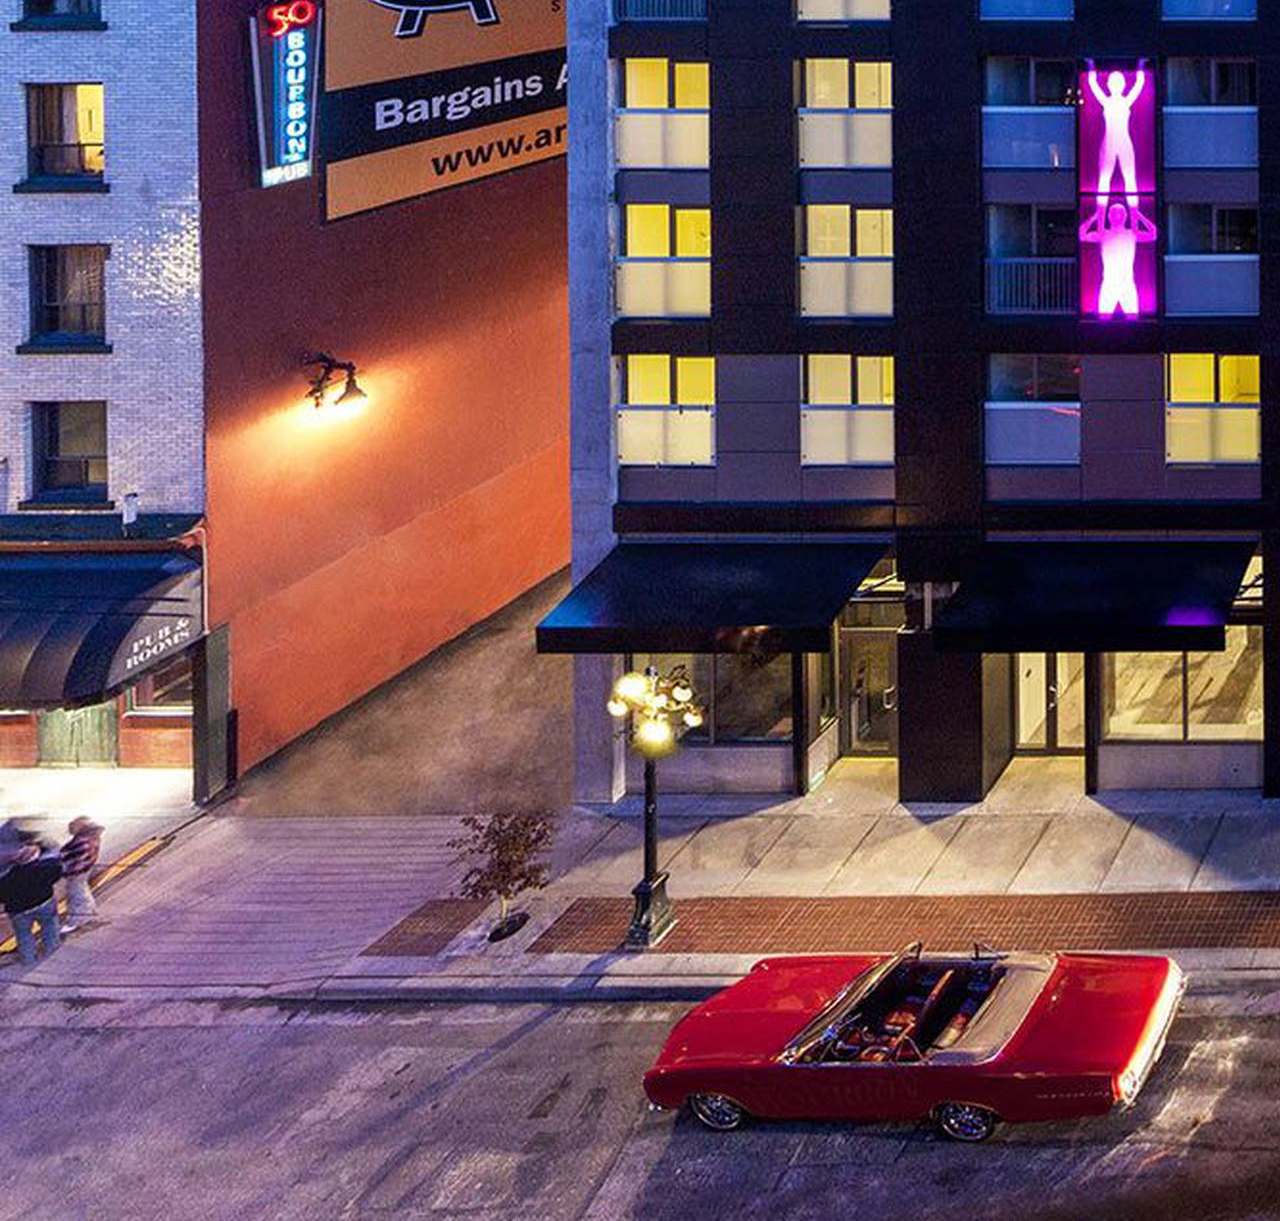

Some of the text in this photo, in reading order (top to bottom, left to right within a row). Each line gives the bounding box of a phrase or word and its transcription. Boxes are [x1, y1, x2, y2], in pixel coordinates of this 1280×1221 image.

[267, 0, 317, 37] 50
[285, 31, 307, 153] BOURBON
[374, 74, 543, 131] Bargains
[126, 631, 190, 670] ROOMS
